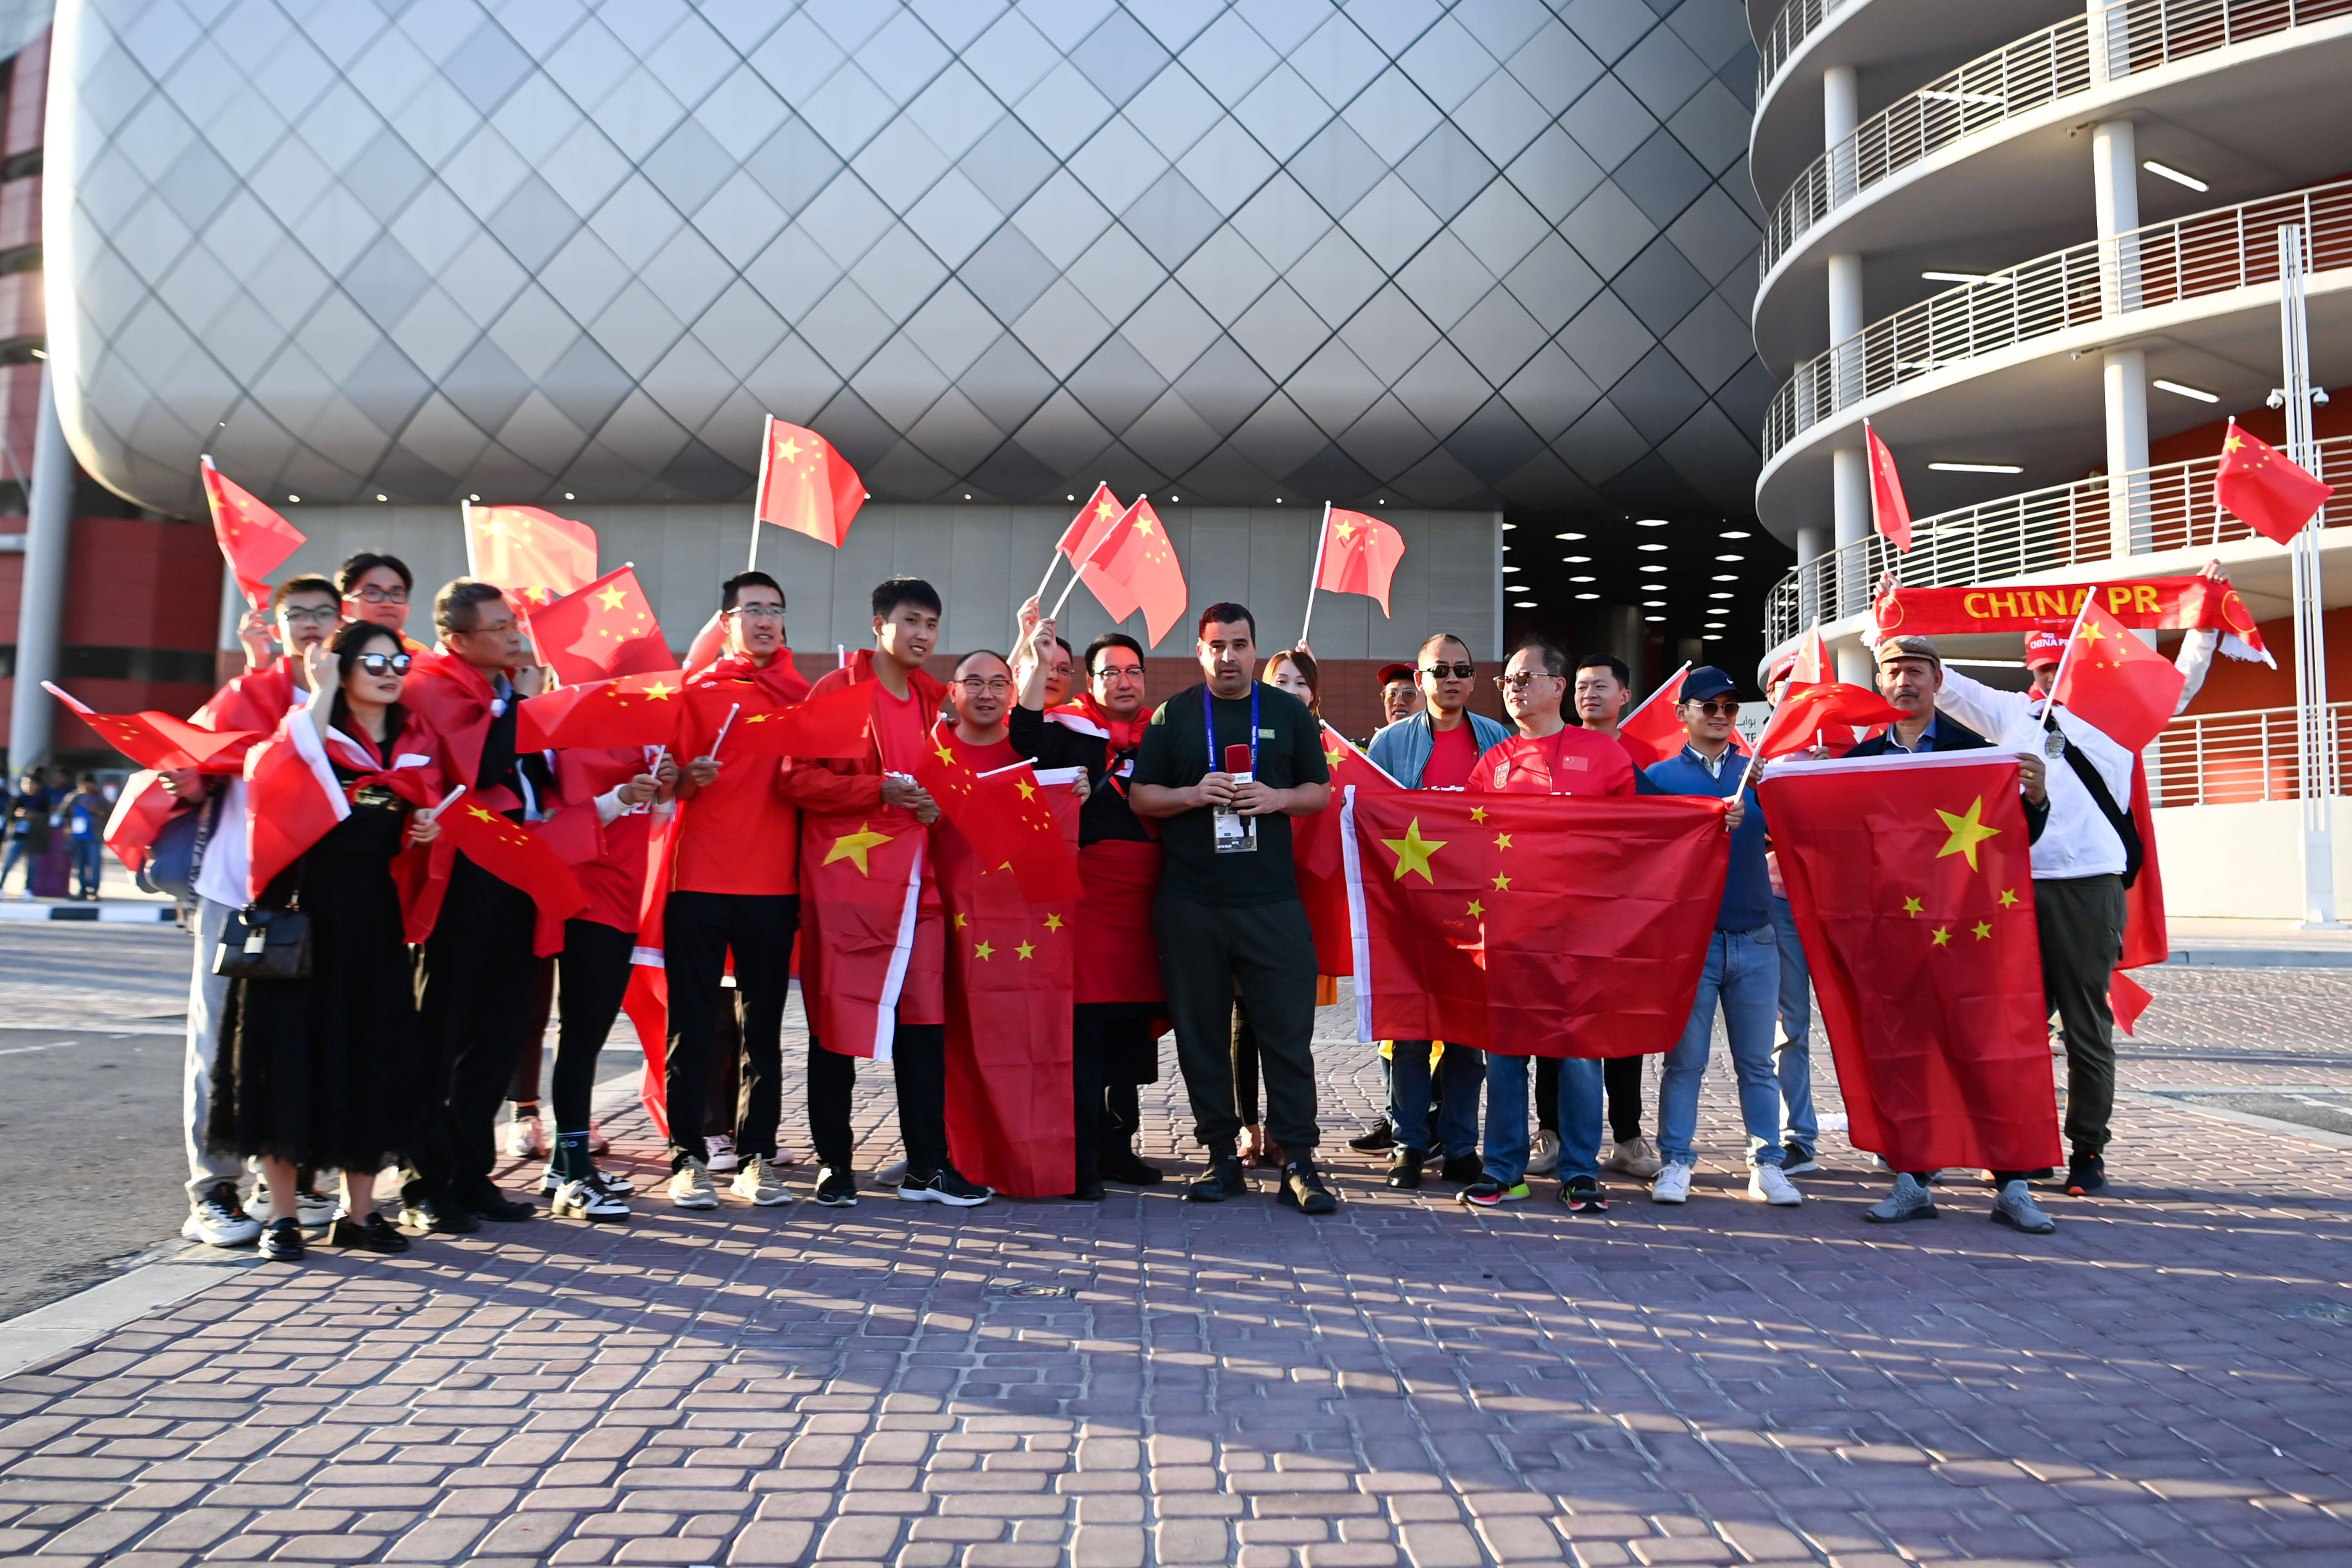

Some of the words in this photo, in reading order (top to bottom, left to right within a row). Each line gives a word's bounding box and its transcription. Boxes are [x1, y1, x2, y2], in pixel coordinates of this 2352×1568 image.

[1964, 589, 2089, 618] CHINA
[2107, 586, 2163, 614] PR
[2030, 638, 2058, 649] CHINA
[1777, 660, 1795, 672] CHIN
